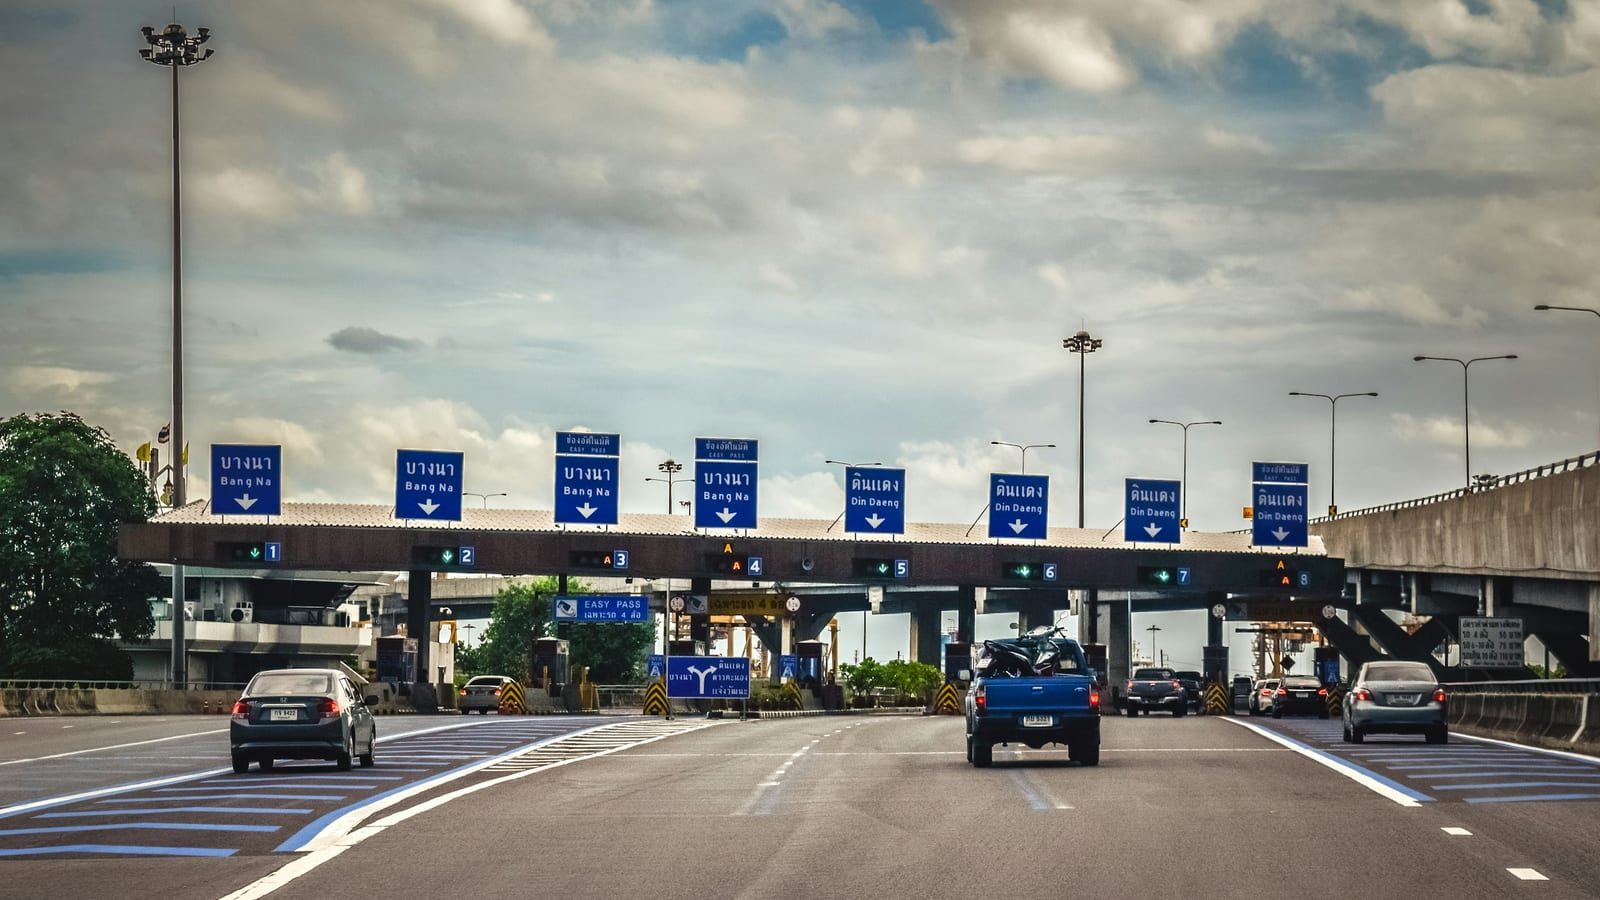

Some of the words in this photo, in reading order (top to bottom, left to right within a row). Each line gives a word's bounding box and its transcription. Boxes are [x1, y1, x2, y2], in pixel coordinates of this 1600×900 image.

[221, 456, 272, 470] บางนา
[406, 461, 454, 477] บางนา
[564, 467, 611, 480] บางนา
[704, 472, 749, 485] บางนา
[221, 477, 252, 488] Bang
[256, 477, 271, 486] Na
[405, 482, 435, 493] Bang
[439, 483, 453, 492] Na
[852, 473, 899, 492] ดินแดง
[996, 479, 1042, 498] ดินแดง
[564, 486, 592, 497] Bang
[597, 487, 610, 497] Na
[704, 491, 731, 502] Bang
[736, 492, 749, 501] Na
[1131, 483, 1175, 503] ดินแดง
[851, 497, 866, 506] Din
[869, 498, 899, 509] Daeng
[1258, 489, 1302, 507] ดินแดง
[995, 503, 1010, 511] Din
[1013, 503, 1042, 515] Daeng
[1131, 508, 1145, 516] Din
[1147, 508, 1175, 519] Daeng
[1258, 512, 1272, 521] Din
[1275, 512, 1303, 523] Daeng
[270, 546, 276, 559] 1
[724, 544, 732, 553] A
[462, 550, 471, 563] 2
[604, 556, 611, 564] A
[617, 554, 626, 566] 3
[733, 561, 740, 570] A
[750, 560, 760, 572] 4
[897, 562, 906, 574] 5
[1277, 560, 1284, 569] A
[1045, 566, 1054, 578] 6
[1180, 571, 1187, 582] 7
[1282, 576, 1290, 585] A
[1301, 574, 1308, 585] 8
[585, 600, 610, 608] EASY
[616, 601, 641, 609] PASS
[759, 599, 765, 609] 4
[669, 673, 693, 681] บางนา
